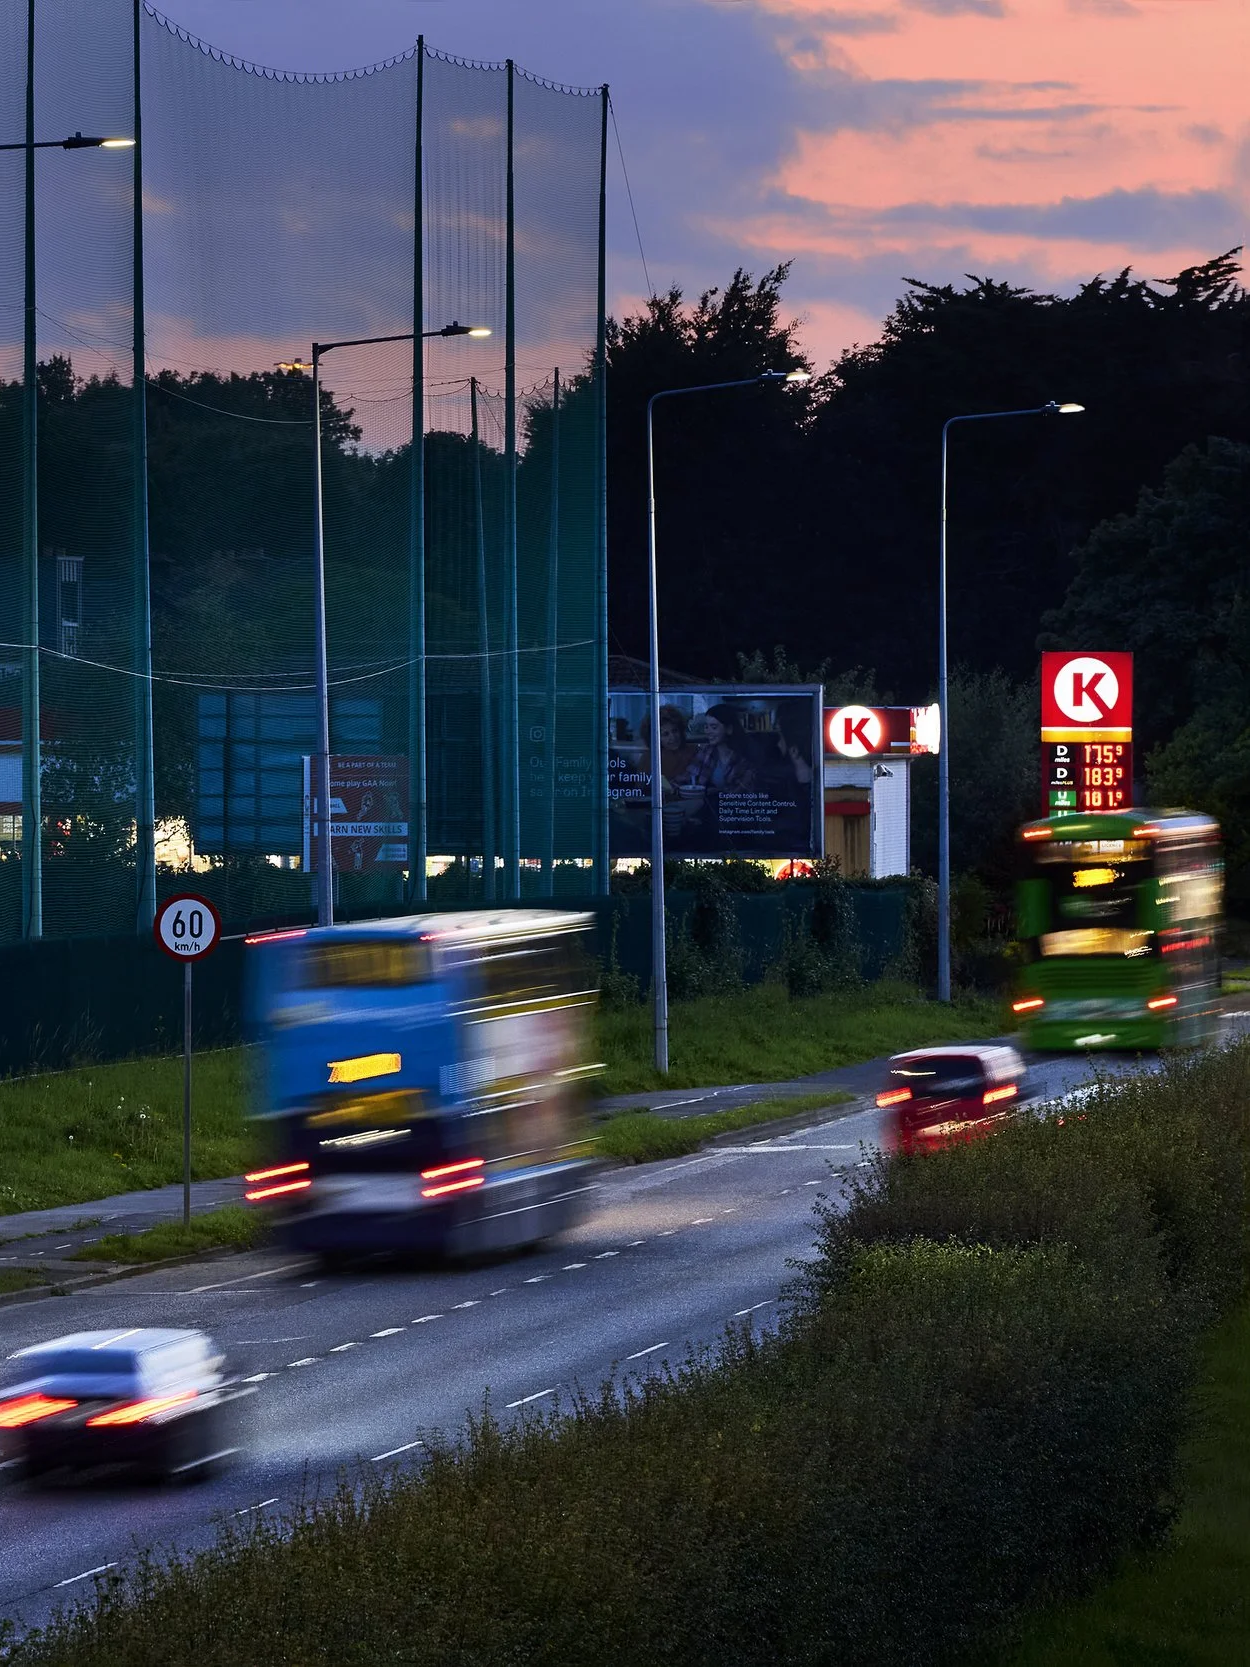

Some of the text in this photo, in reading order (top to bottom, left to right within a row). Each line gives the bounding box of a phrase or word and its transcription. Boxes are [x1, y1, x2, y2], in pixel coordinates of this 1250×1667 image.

[1073, 673, 1113, 718] K
[844, 718, 875, 753] K
[1057, 745, 1123, 764] D 175.9
[619, 772, 653, 785] family
[1057, 768, 1123, 786] D 183.9
[718, 792, 742, 800] Explore
[330, 825, 403, 834] ARN NEW SKILLS
[172, 910, 203, 938] 60
[174, 941, 200, 951] km/h
